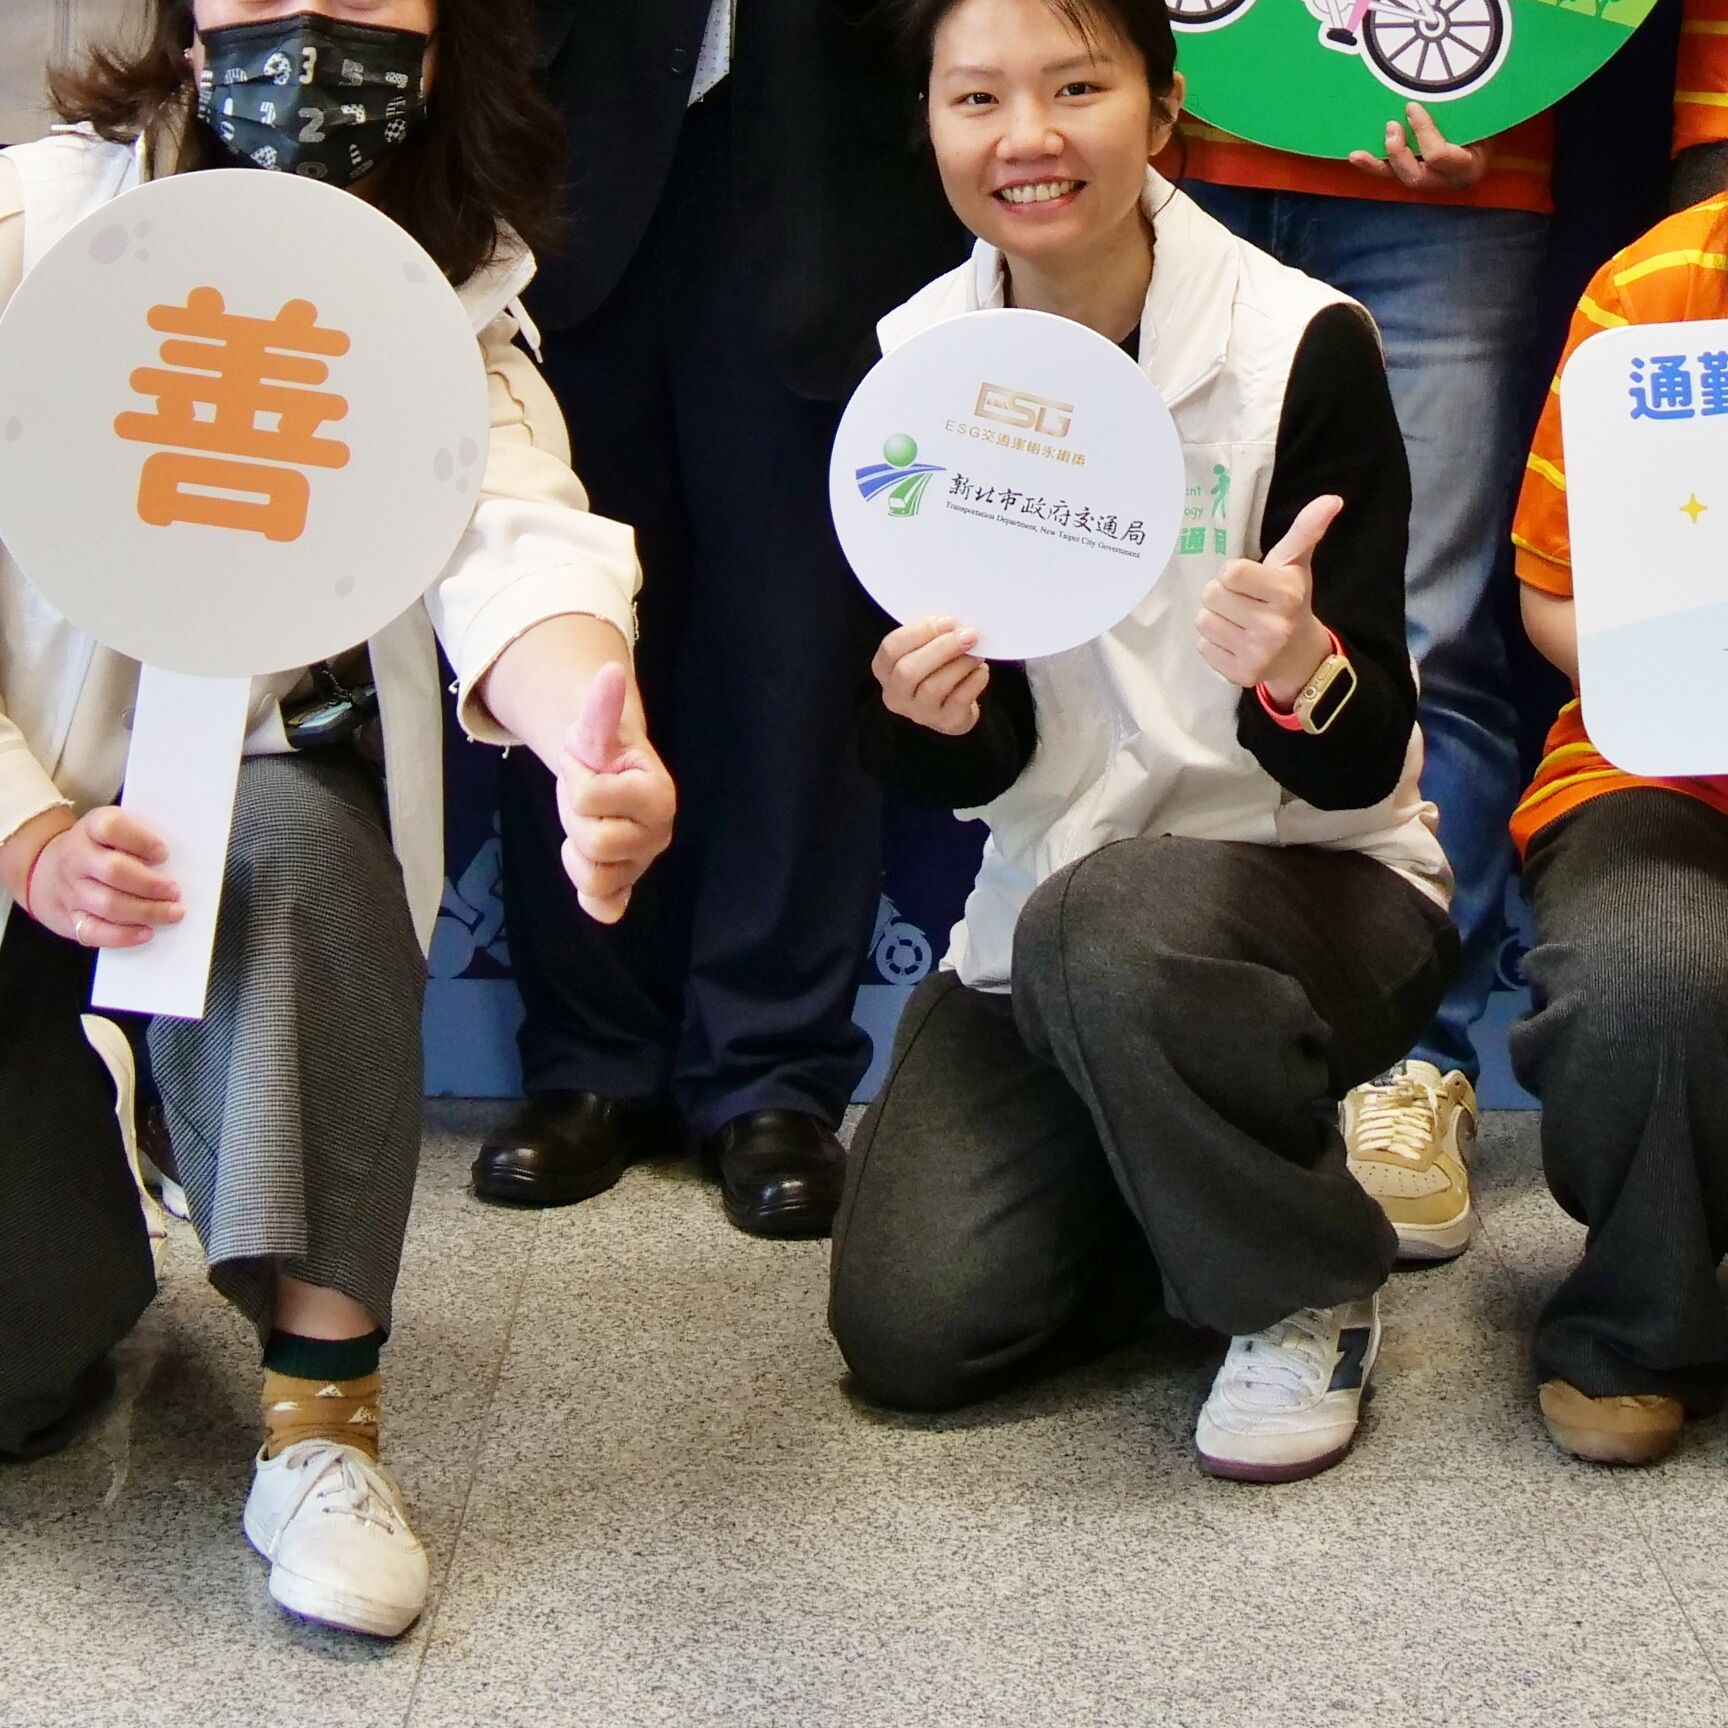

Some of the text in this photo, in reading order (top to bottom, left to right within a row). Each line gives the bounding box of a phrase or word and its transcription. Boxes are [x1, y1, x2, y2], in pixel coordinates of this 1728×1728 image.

[112, 285, 352, 544] 善
[945, 500, 995, 520] Transportation
[1040, 525, 1056, 536] New
[1058, 530, 1081, 543] Taipei
[1081, 537, 1096, 549] City
[1098, 541, 1141, 559] Government
[948, 472, 1147, 546] 新北市政府交通局
